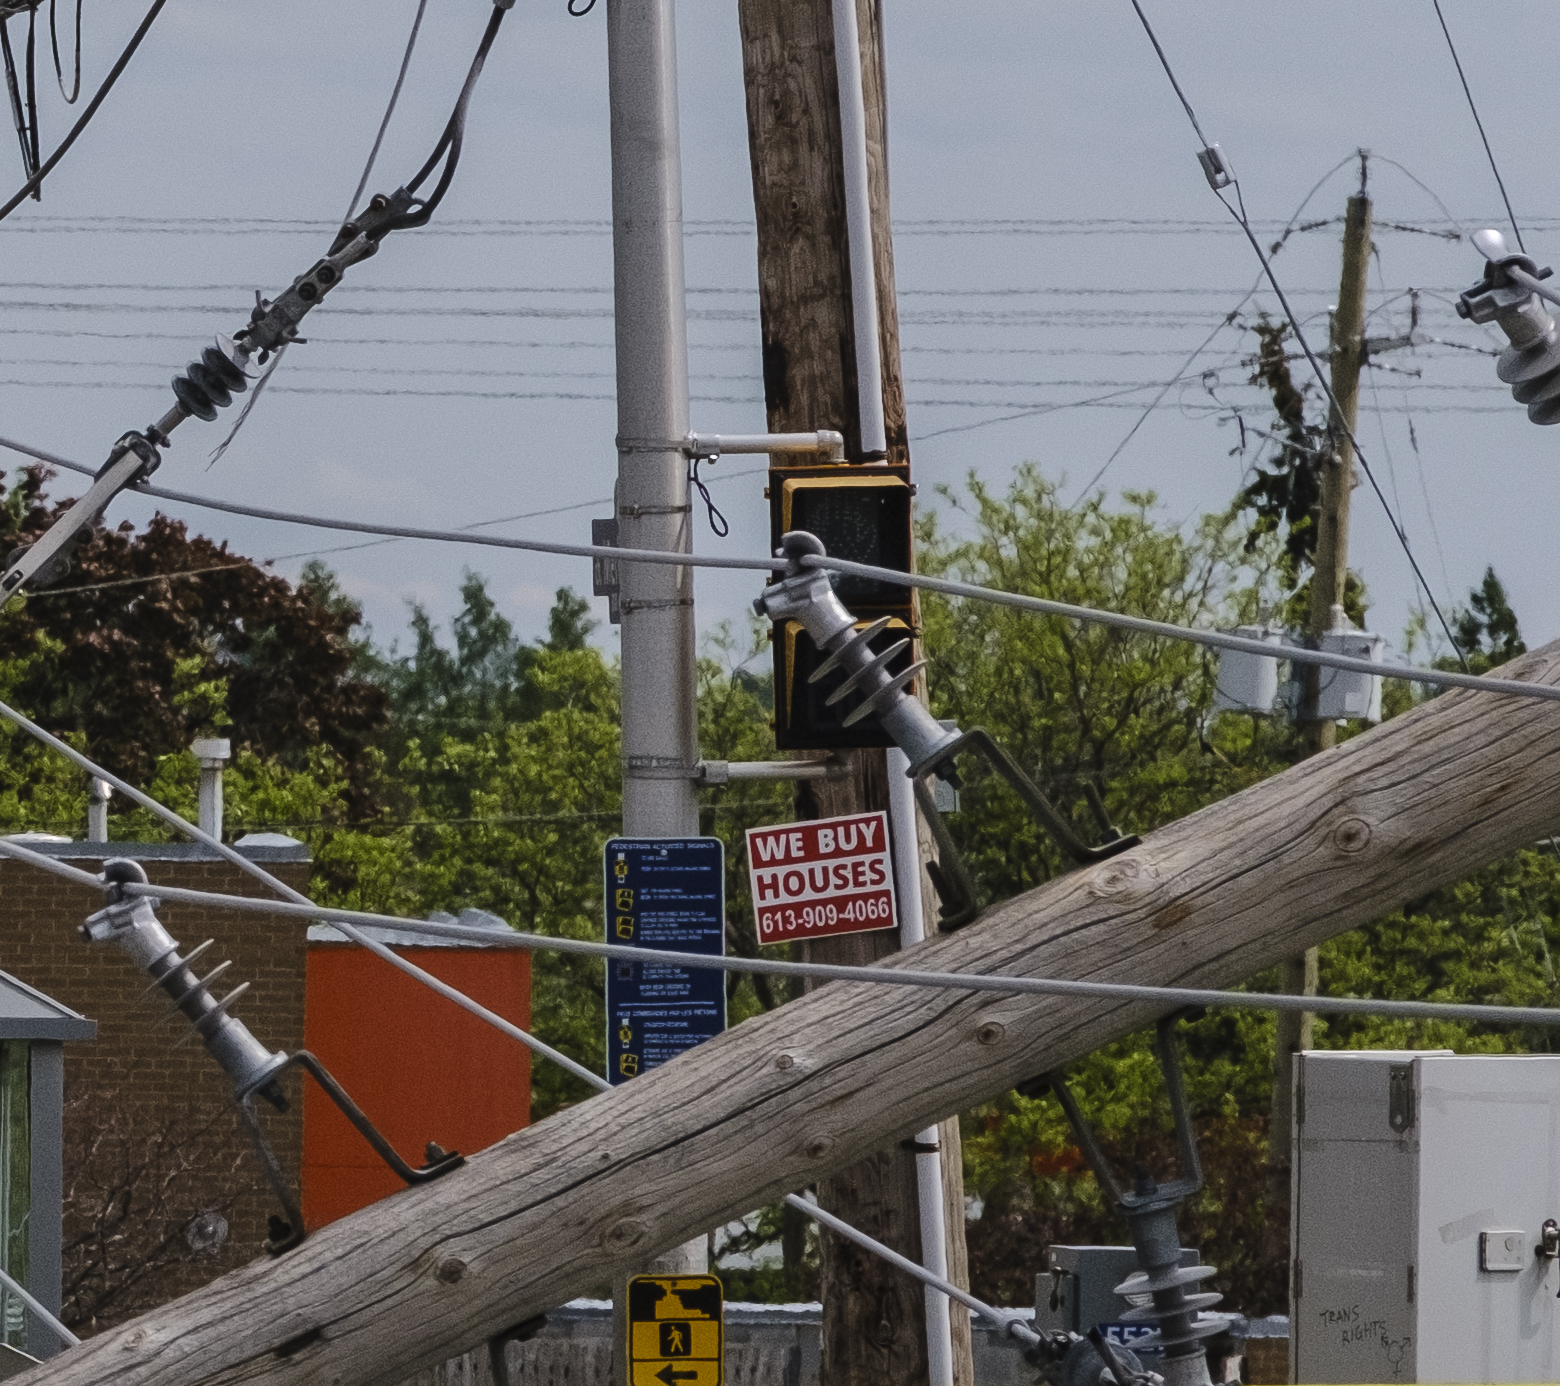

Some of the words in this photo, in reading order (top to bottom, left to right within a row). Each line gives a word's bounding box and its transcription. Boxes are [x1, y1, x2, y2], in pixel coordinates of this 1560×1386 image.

[755, 832, 805, 862] WE
[817, 820, 877, 854] BUY
[756, 858, 887, 901] HOUSES
[762, 896, 890, 934] 613-909-4066
[1318, 1304, 1360, 1328] TRANS
[1341, 1320, 1388, 1344] RIGHTS
